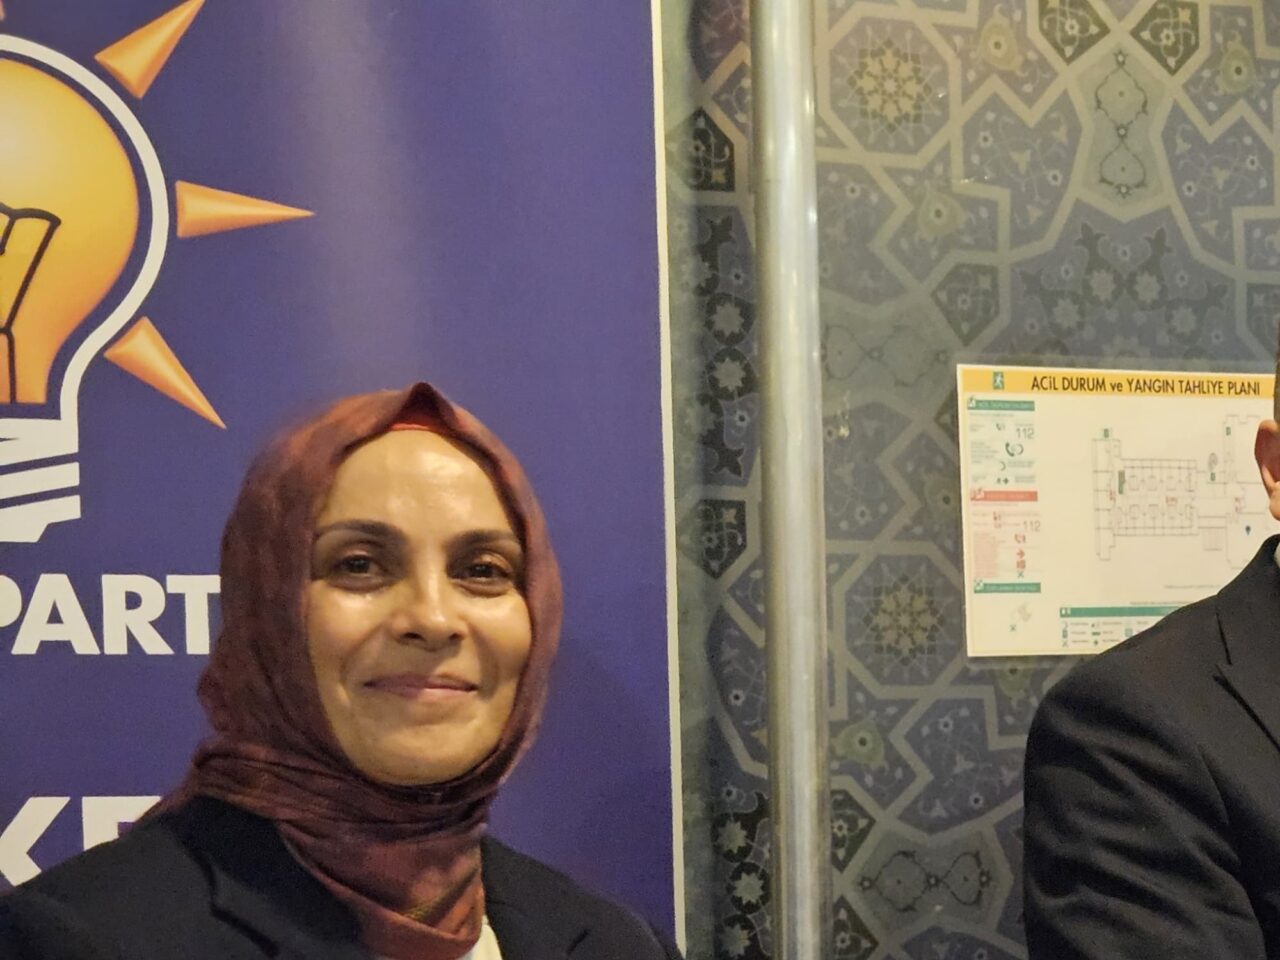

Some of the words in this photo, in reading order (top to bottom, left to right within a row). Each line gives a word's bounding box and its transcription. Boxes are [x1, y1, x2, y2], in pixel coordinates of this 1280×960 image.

[1062, 377, 1107, 392] DURUM
[1109, 381, 1124, 393] ve
[1126, 378, 1175, 394] YANGIN
[1227, 381, 1260, 396] PLANI
[1015, 427, 1035, 440] 112
